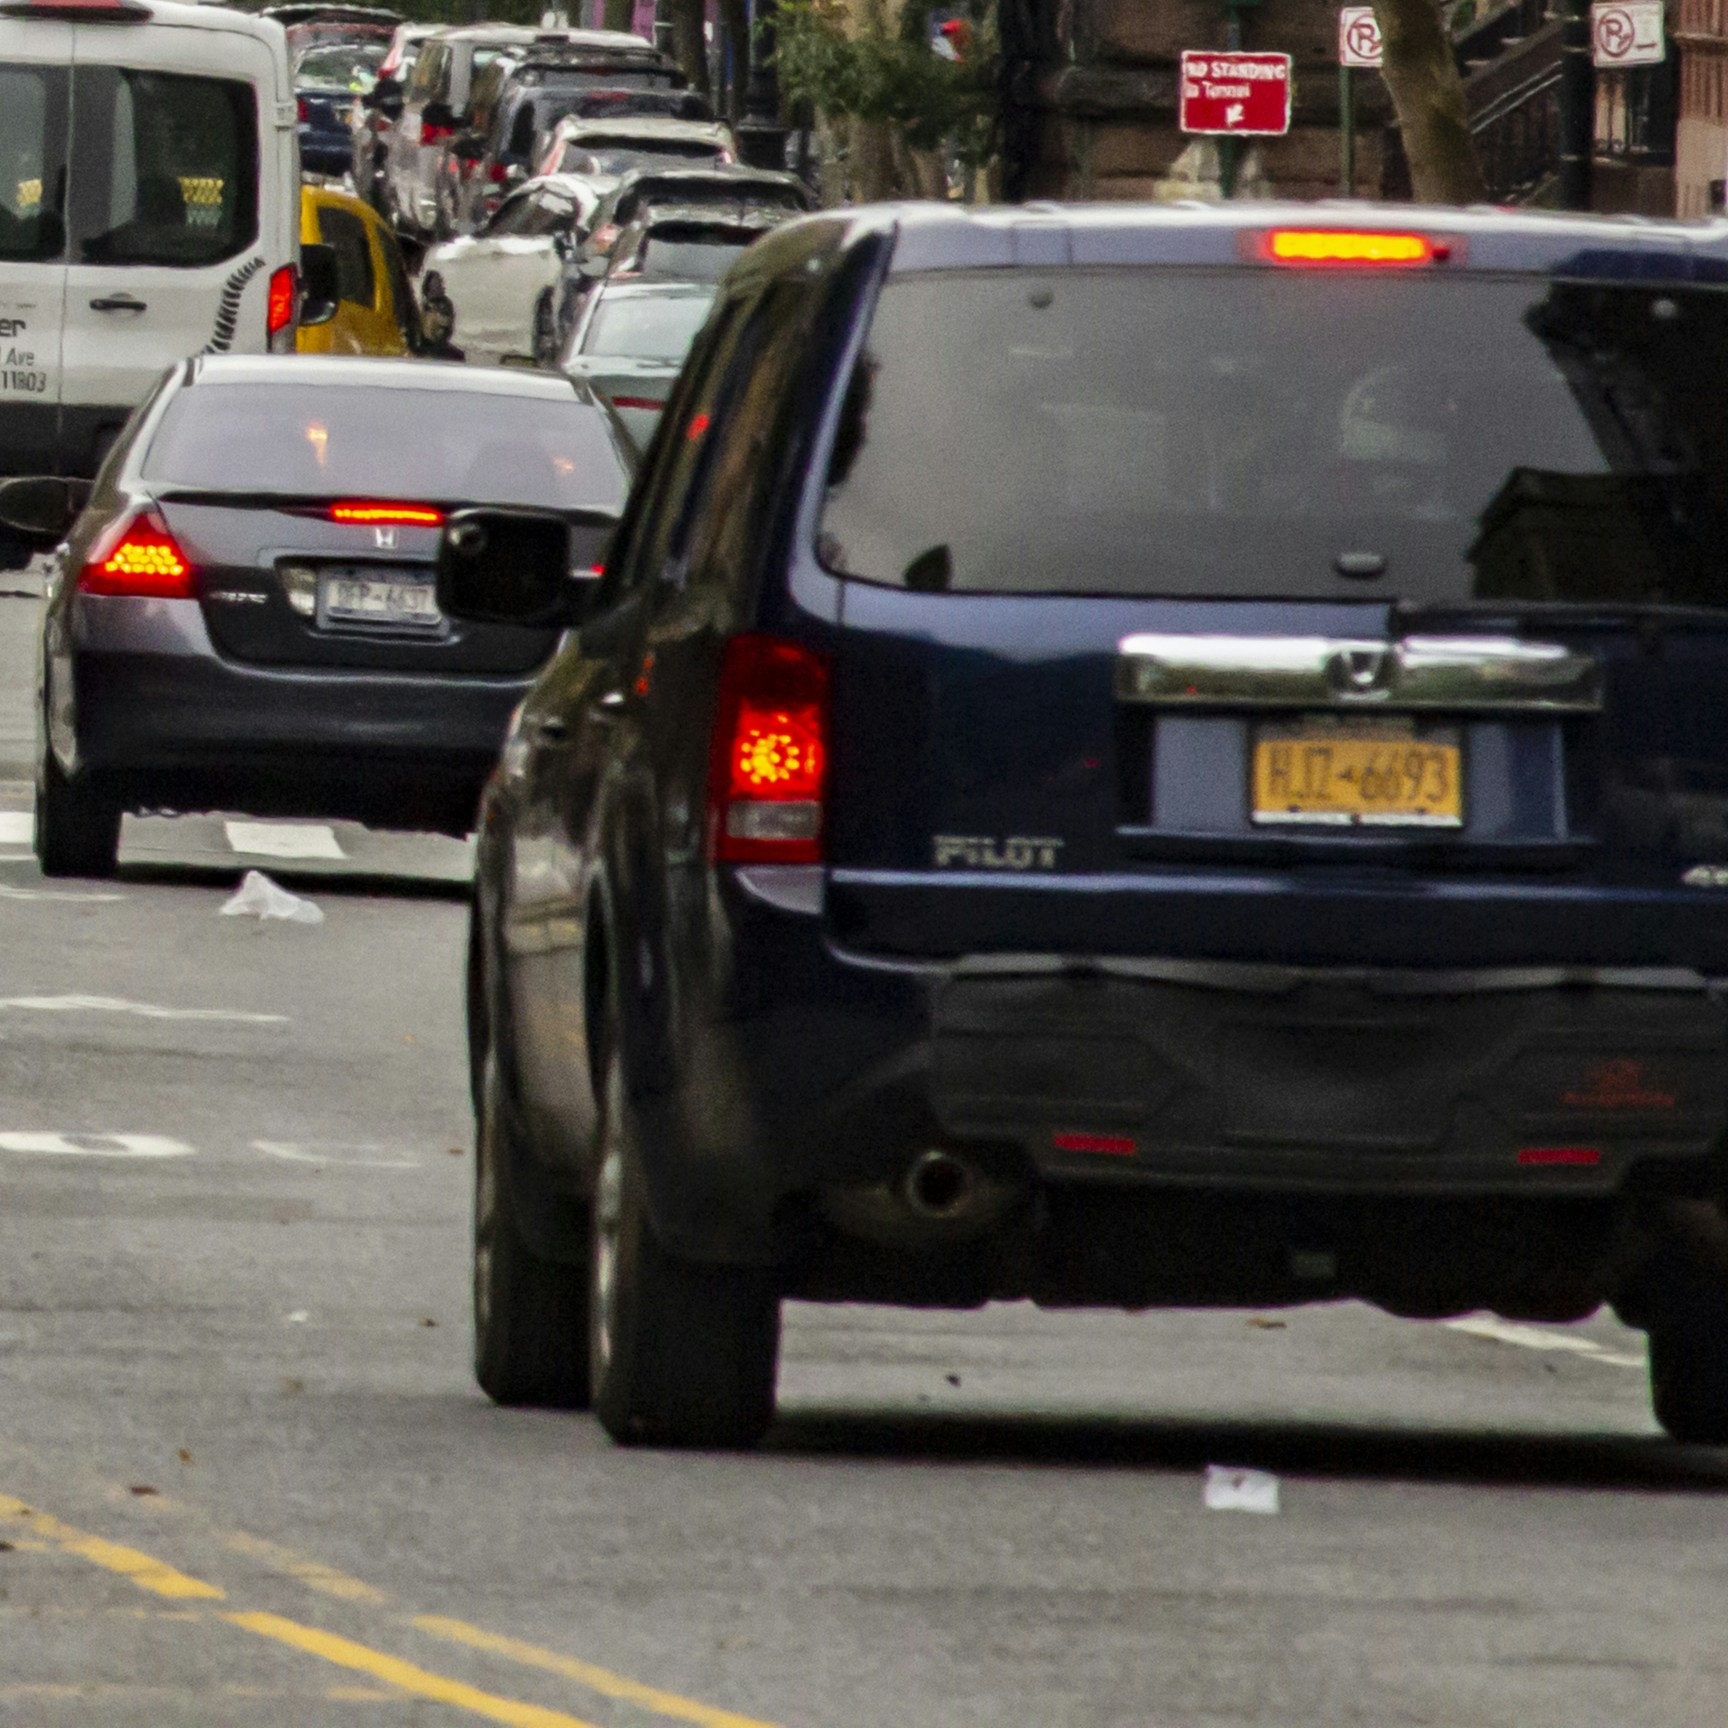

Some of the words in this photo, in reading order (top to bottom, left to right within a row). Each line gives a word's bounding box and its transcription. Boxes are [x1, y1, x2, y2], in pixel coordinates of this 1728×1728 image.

[1186, 61, 1209, 77] NO
[1211, 61, 1286, 81] STANDING
[1201, 80, 1251, 99] Tunnel
[5, 347, 35, 367] Ave
[933, 834, 1066, 870] PILOT
